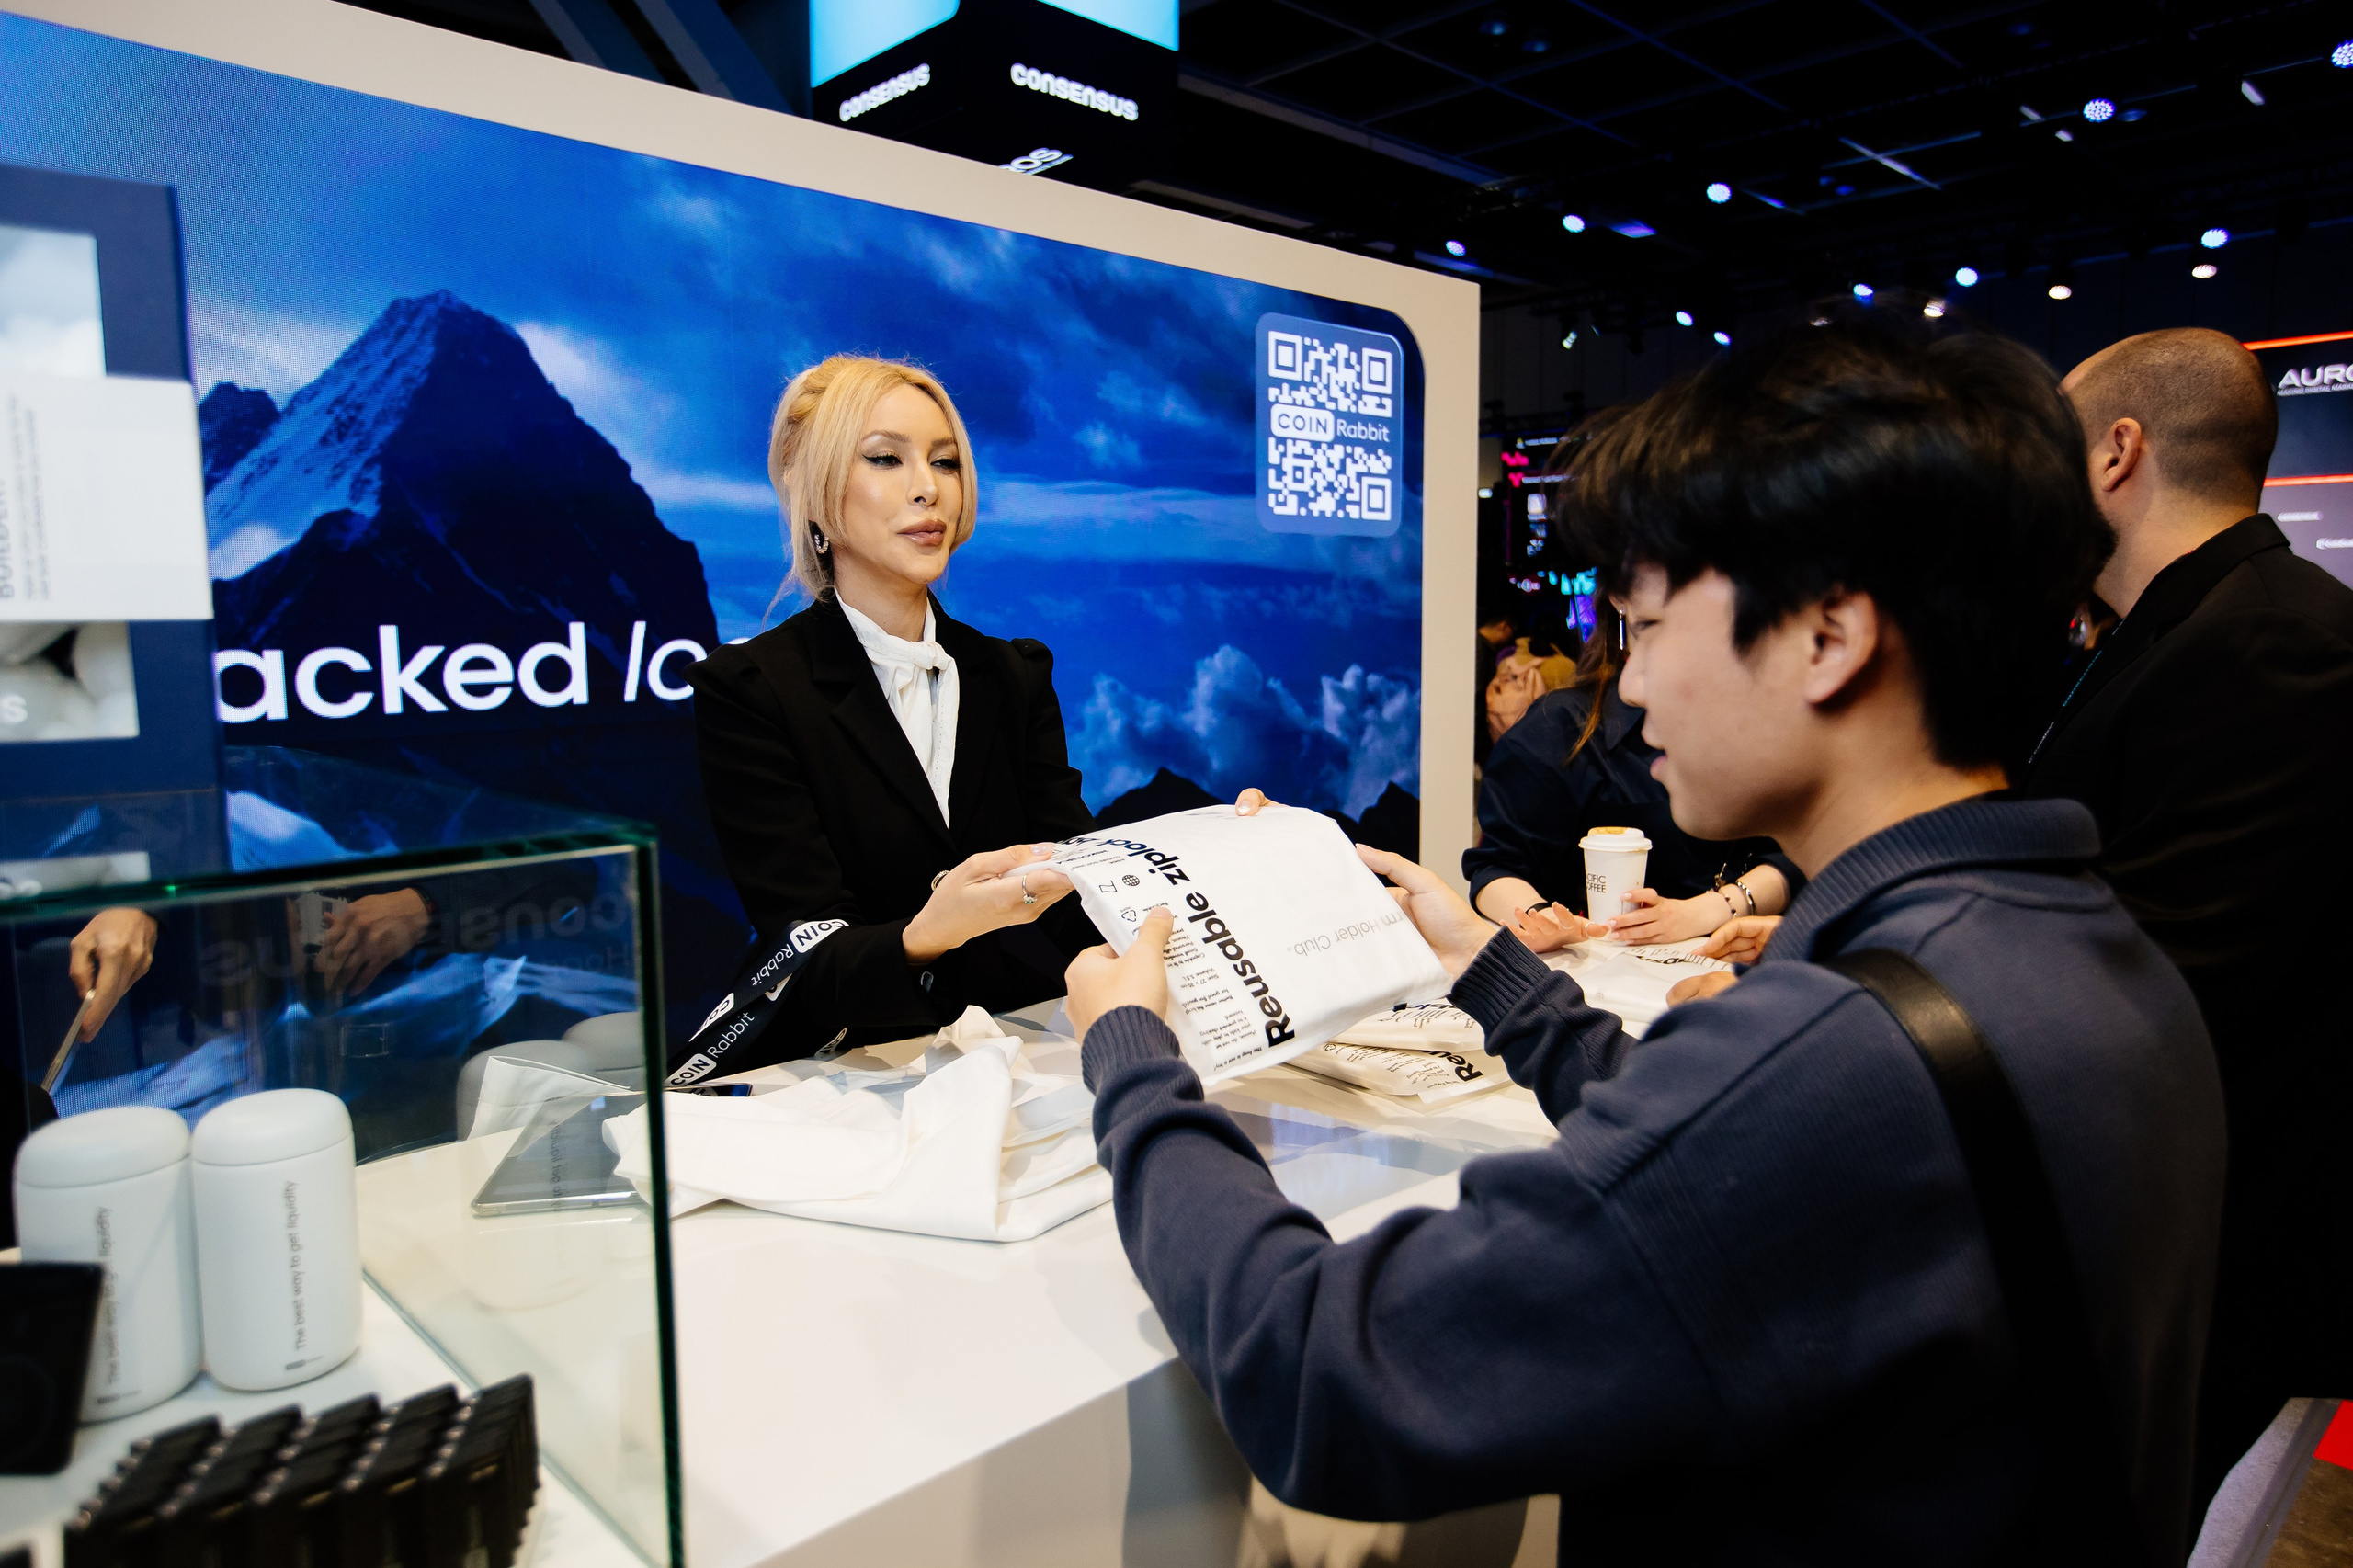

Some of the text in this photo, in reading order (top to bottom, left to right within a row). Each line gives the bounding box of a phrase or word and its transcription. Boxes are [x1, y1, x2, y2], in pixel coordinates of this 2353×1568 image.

[1278, 413, 1391, 442] COIN Rabbit
[215, 620, 751, 722] acked lo
[1586, 873, 1607, 884] CIFIC
[1586, 882, 1607, 893] OFFEE
[1334, 920, 1381, 942] Holder
[1381, 910, 1404, 928] rm
[752, 921, 845, 986] COIN Rabbit
[1186, 892, 1296, 1049] Reusable
[699, 999, 731, 1030] CO
[671, 1011, 755, 1085] COIN Rabbit
[1425, 1051, 1483, 1082] Reu
[282, 1181, 306, 1350] The best way to get liquidity
